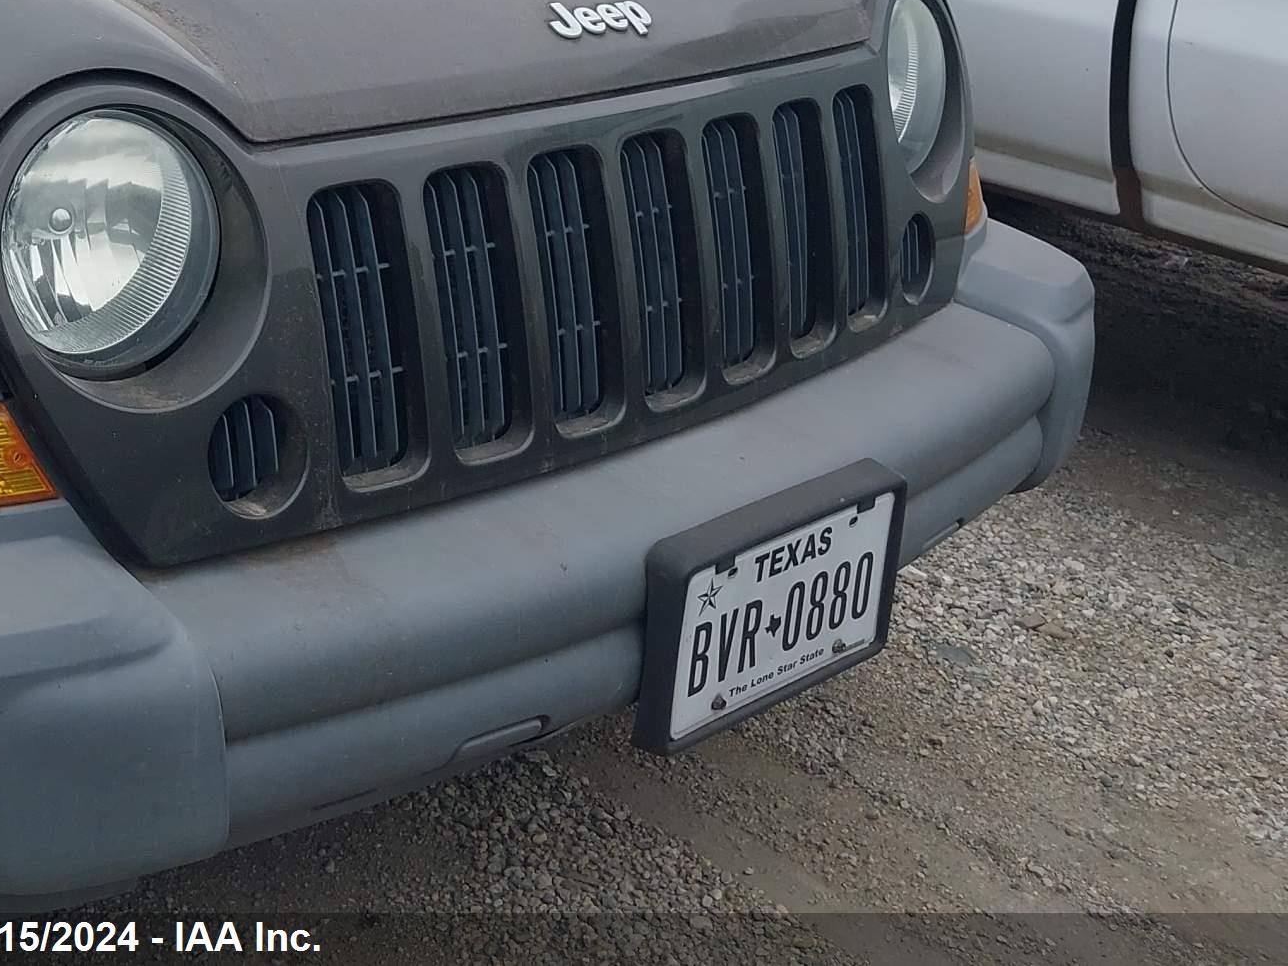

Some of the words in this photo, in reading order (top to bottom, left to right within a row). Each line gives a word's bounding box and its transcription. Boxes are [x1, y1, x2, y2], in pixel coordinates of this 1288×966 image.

[548, 0, 652, 38] Jeep
[755, 526, 833, 583] TEXAS
[687, 599, 763, 698] BVR
[781, 551, 874, 652] 0880
[729, 684, 748, 697] The
[750, 671, 774, 688] Lone
[777, 661, 798, 675] Star
[799, 648, 824, 665] State
